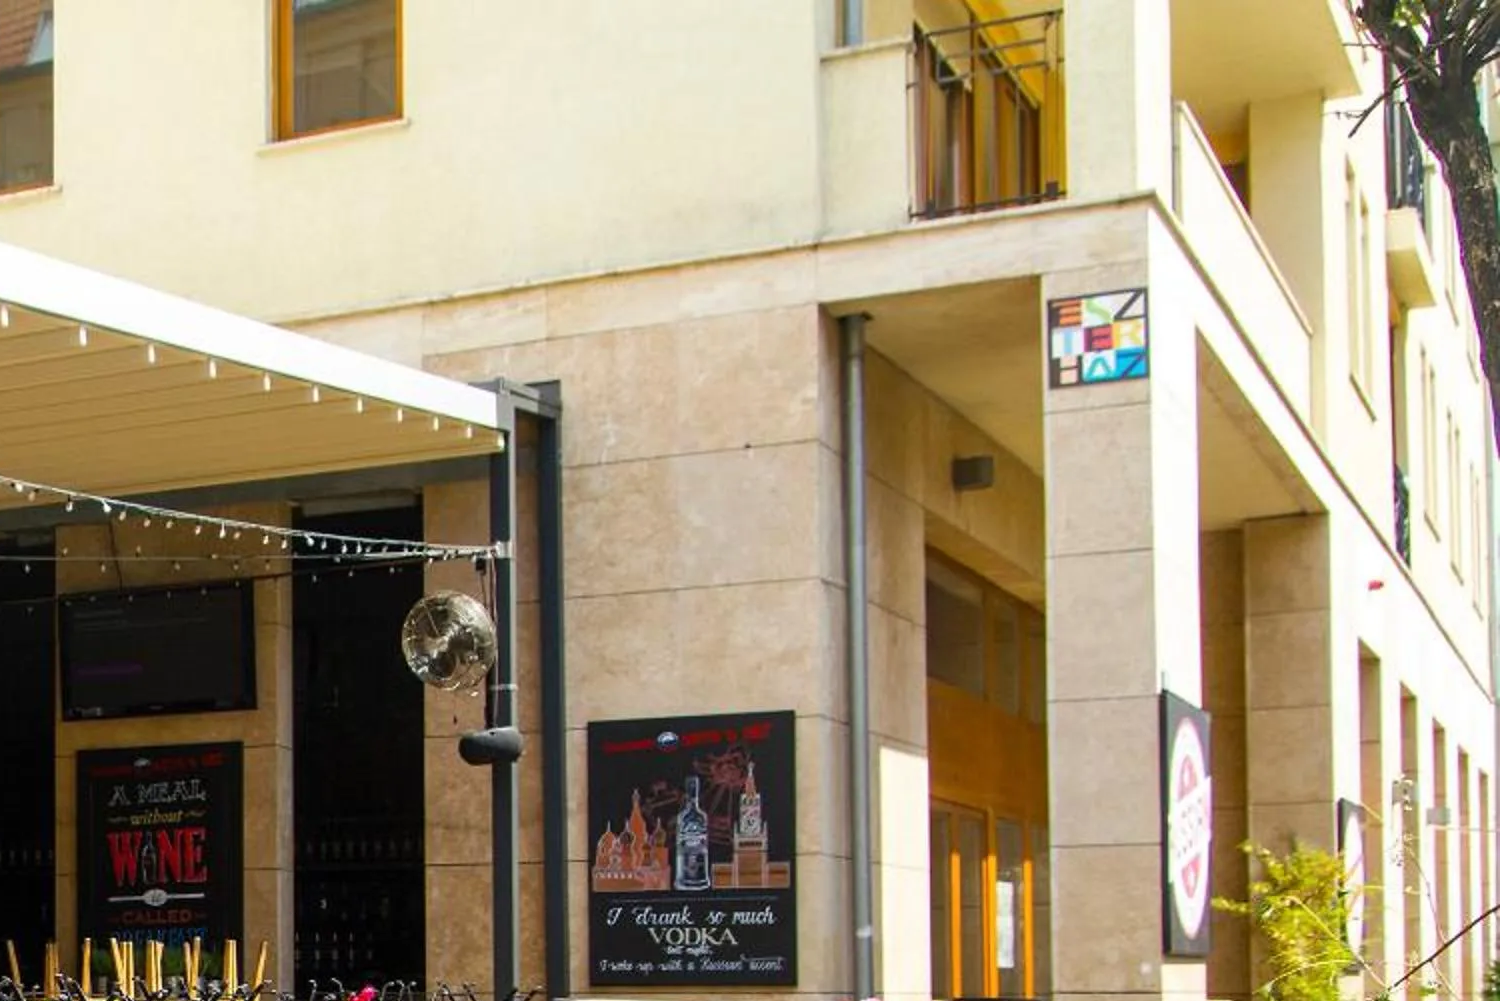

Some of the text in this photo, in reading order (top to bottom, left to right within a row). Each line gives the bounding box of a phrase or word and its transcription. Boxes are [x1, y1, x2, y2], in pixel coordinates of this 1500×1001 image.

[121, 909, 192, 925] CALLED
[632, 905, 694, 925] drank
[706, 910, 726, 925] so
[732, 905, 776, 925] much
[649, 927, 738, 945] VODKA
